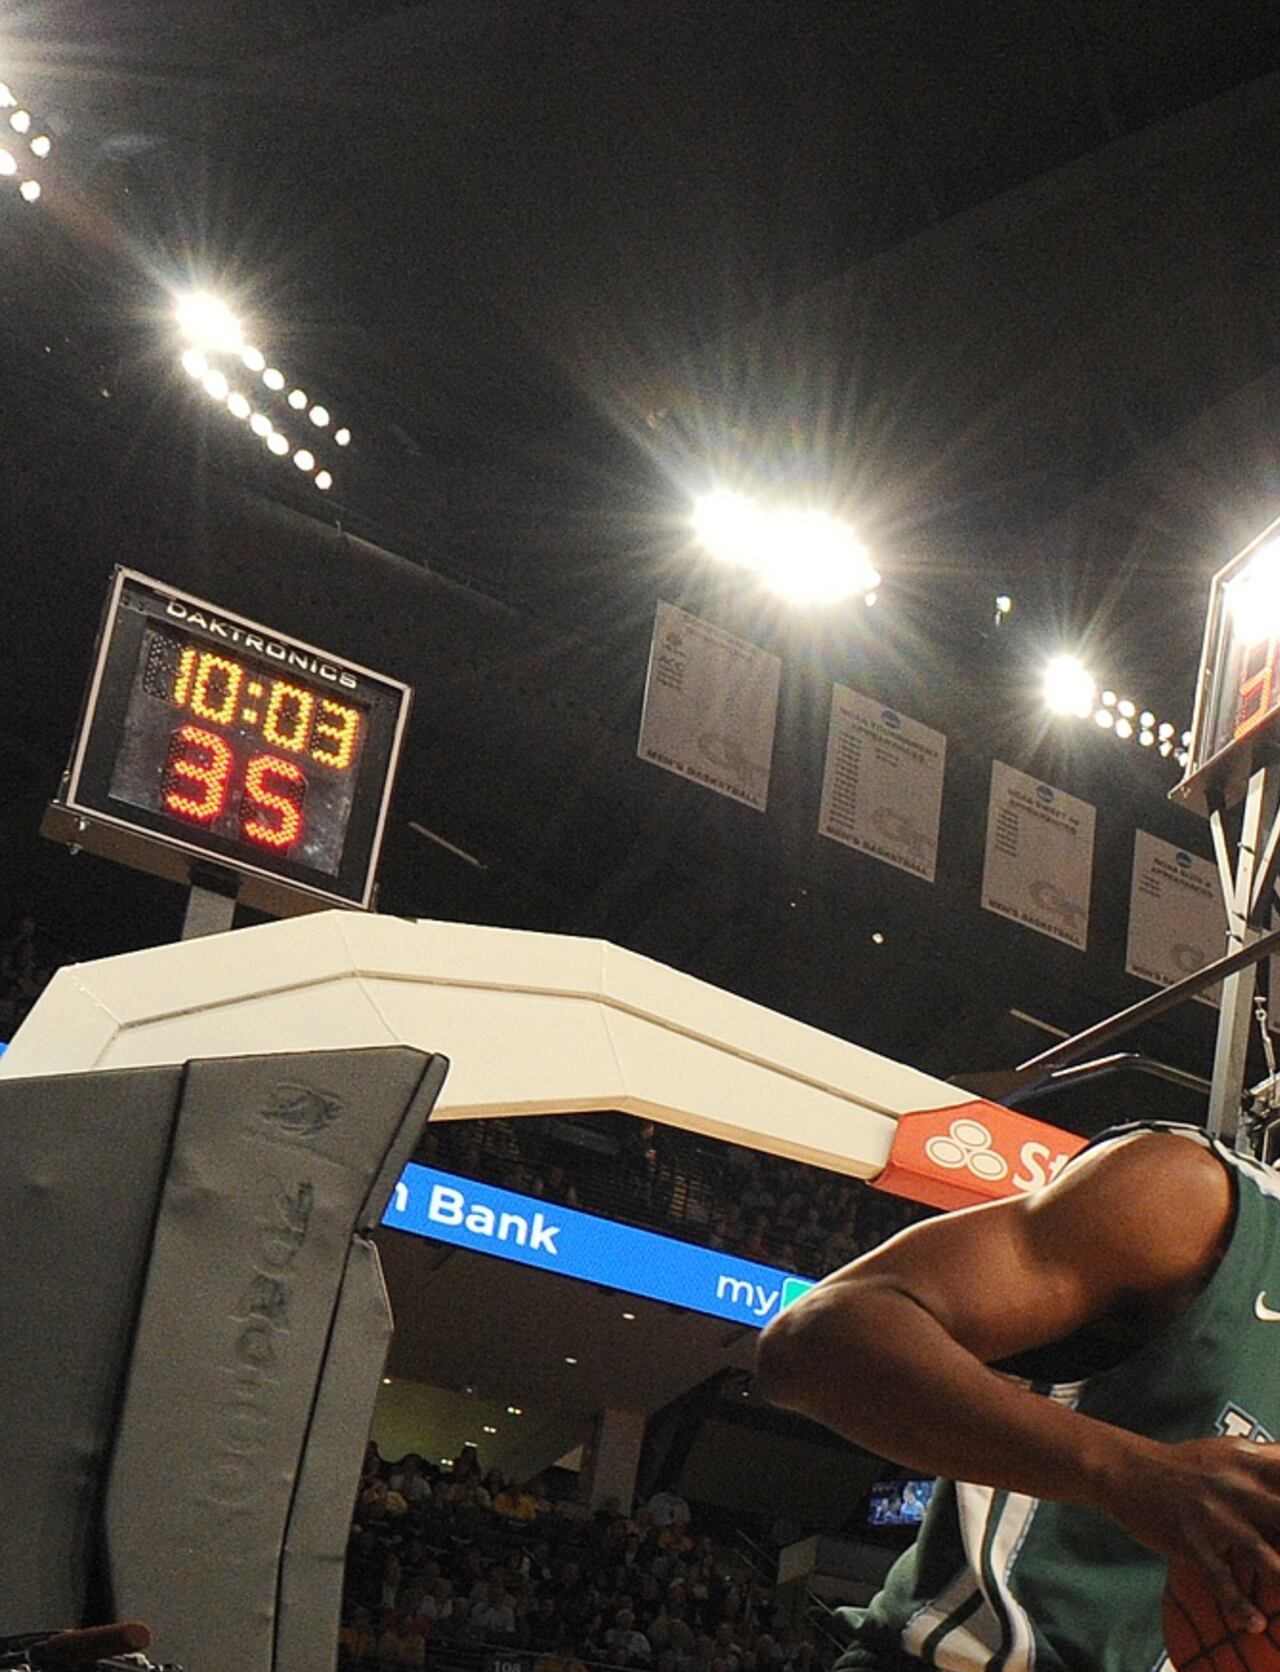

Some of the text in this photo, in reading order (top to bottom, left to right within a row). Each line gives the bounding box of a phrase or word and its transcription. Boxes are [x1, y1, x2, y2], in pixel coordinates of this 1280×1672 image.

[165, 600, 358, 691] DAKTRONICS
[170, 645, 362, 770] 10:03
[166, 724, 304, 848] 35
[428, 1184, 559, 1255] Bank
[716, 1273, 778, 1315] my
